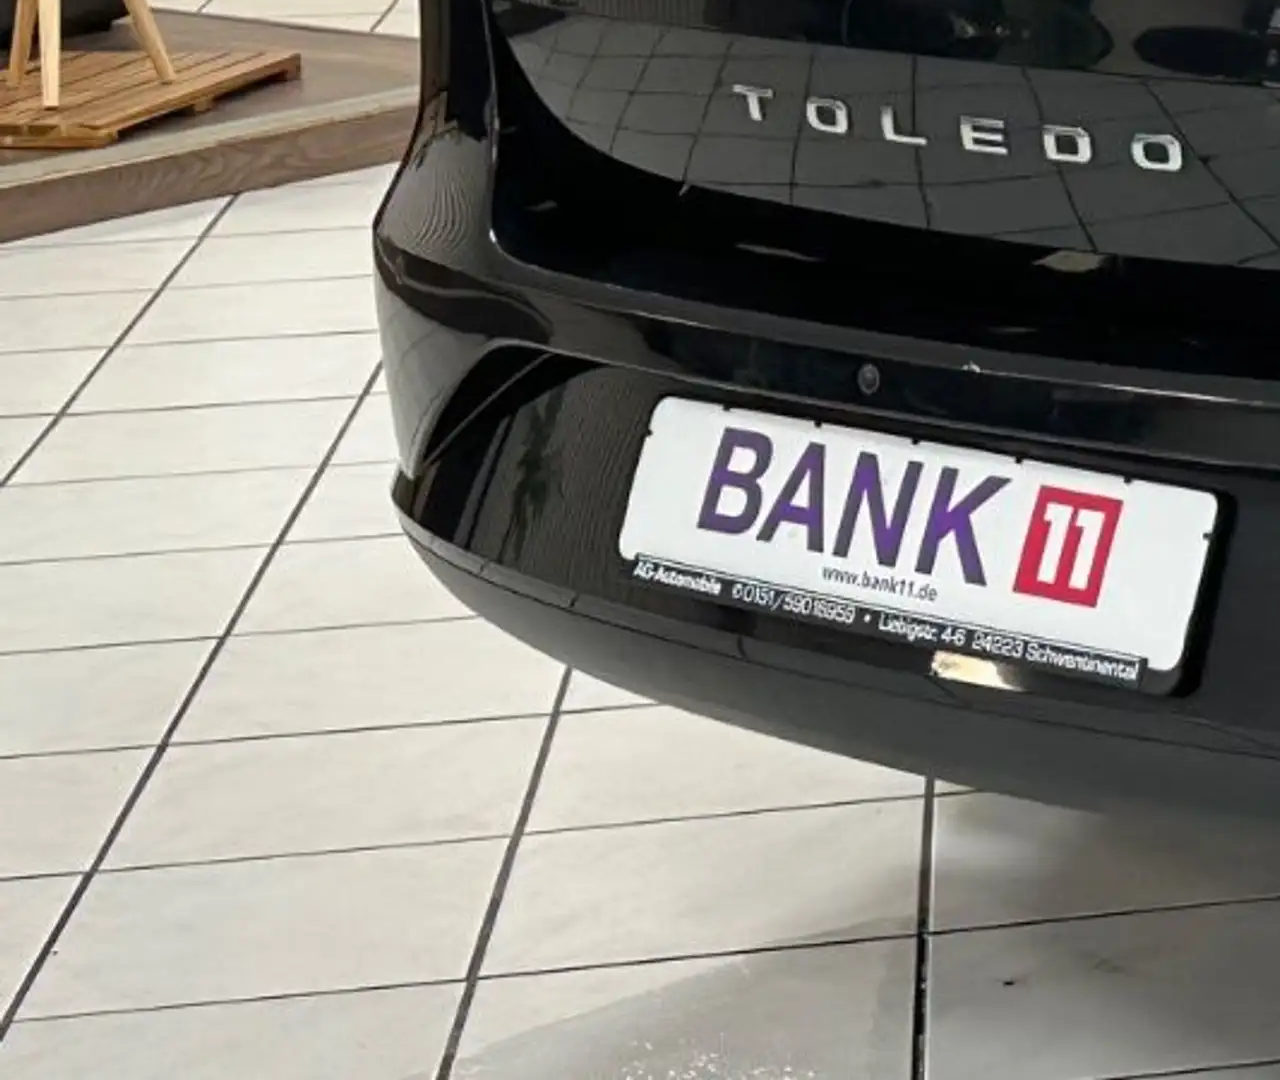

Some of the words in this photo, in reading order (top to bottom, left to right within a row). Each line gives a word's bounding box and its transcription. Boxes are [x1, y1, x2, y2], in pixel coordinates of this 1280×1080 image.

[732, 83, 1183, 172] TOLEDO
[696, 426, 1012, 587] BANK
[1033, 500, 1108, 592] 11
[822, 566, 938, 602] www.bank11.de
[971, 630, 1023, 658] 24223
